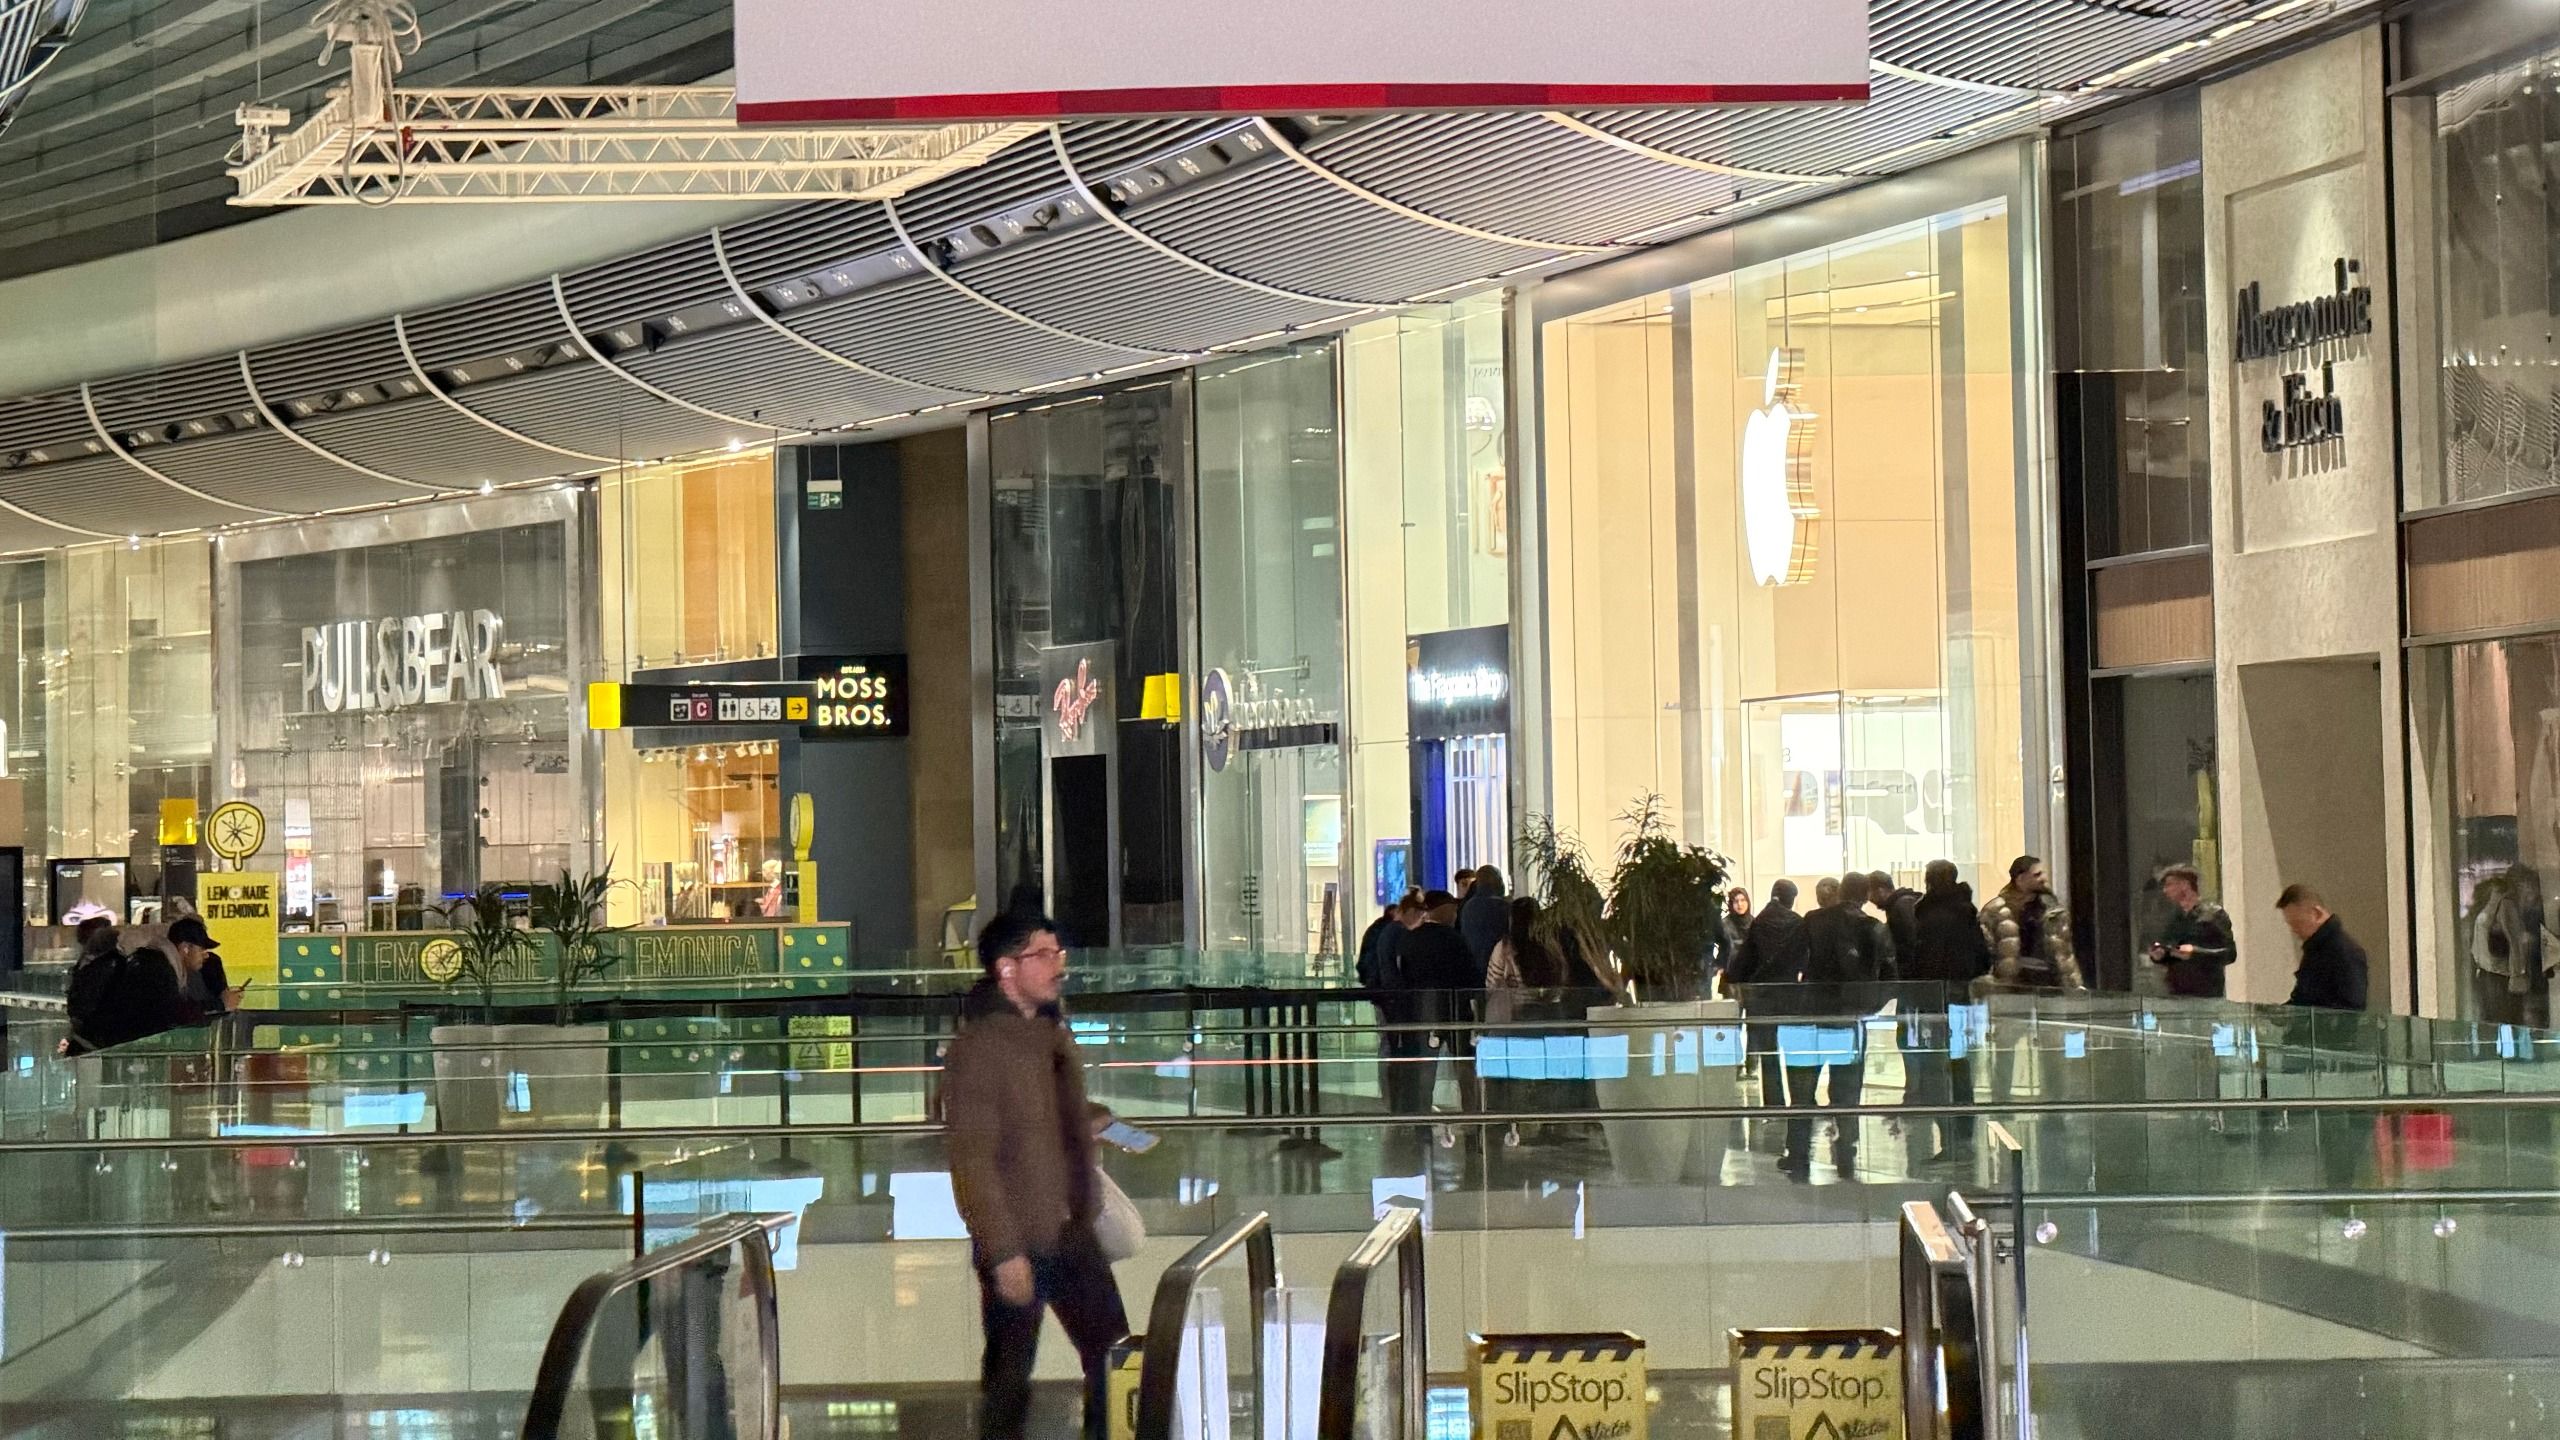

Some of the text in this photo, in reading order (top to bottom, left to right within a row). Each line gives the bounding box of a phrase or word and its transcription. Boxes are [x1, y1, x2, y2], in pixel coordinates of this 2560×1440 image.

[2235, 257, 2371, 362] Abercrombie
[2283, 360, 2343, 447] Fitch
[301, 609, 505, 713] PULL&BEAR
[818, 677, 887, 699] MOSS
[818, 704, 891, 726] BROS.
[207, 903, 270, 919] BY LEMONICA
[618, 934, 762, 978] LEMONICA
